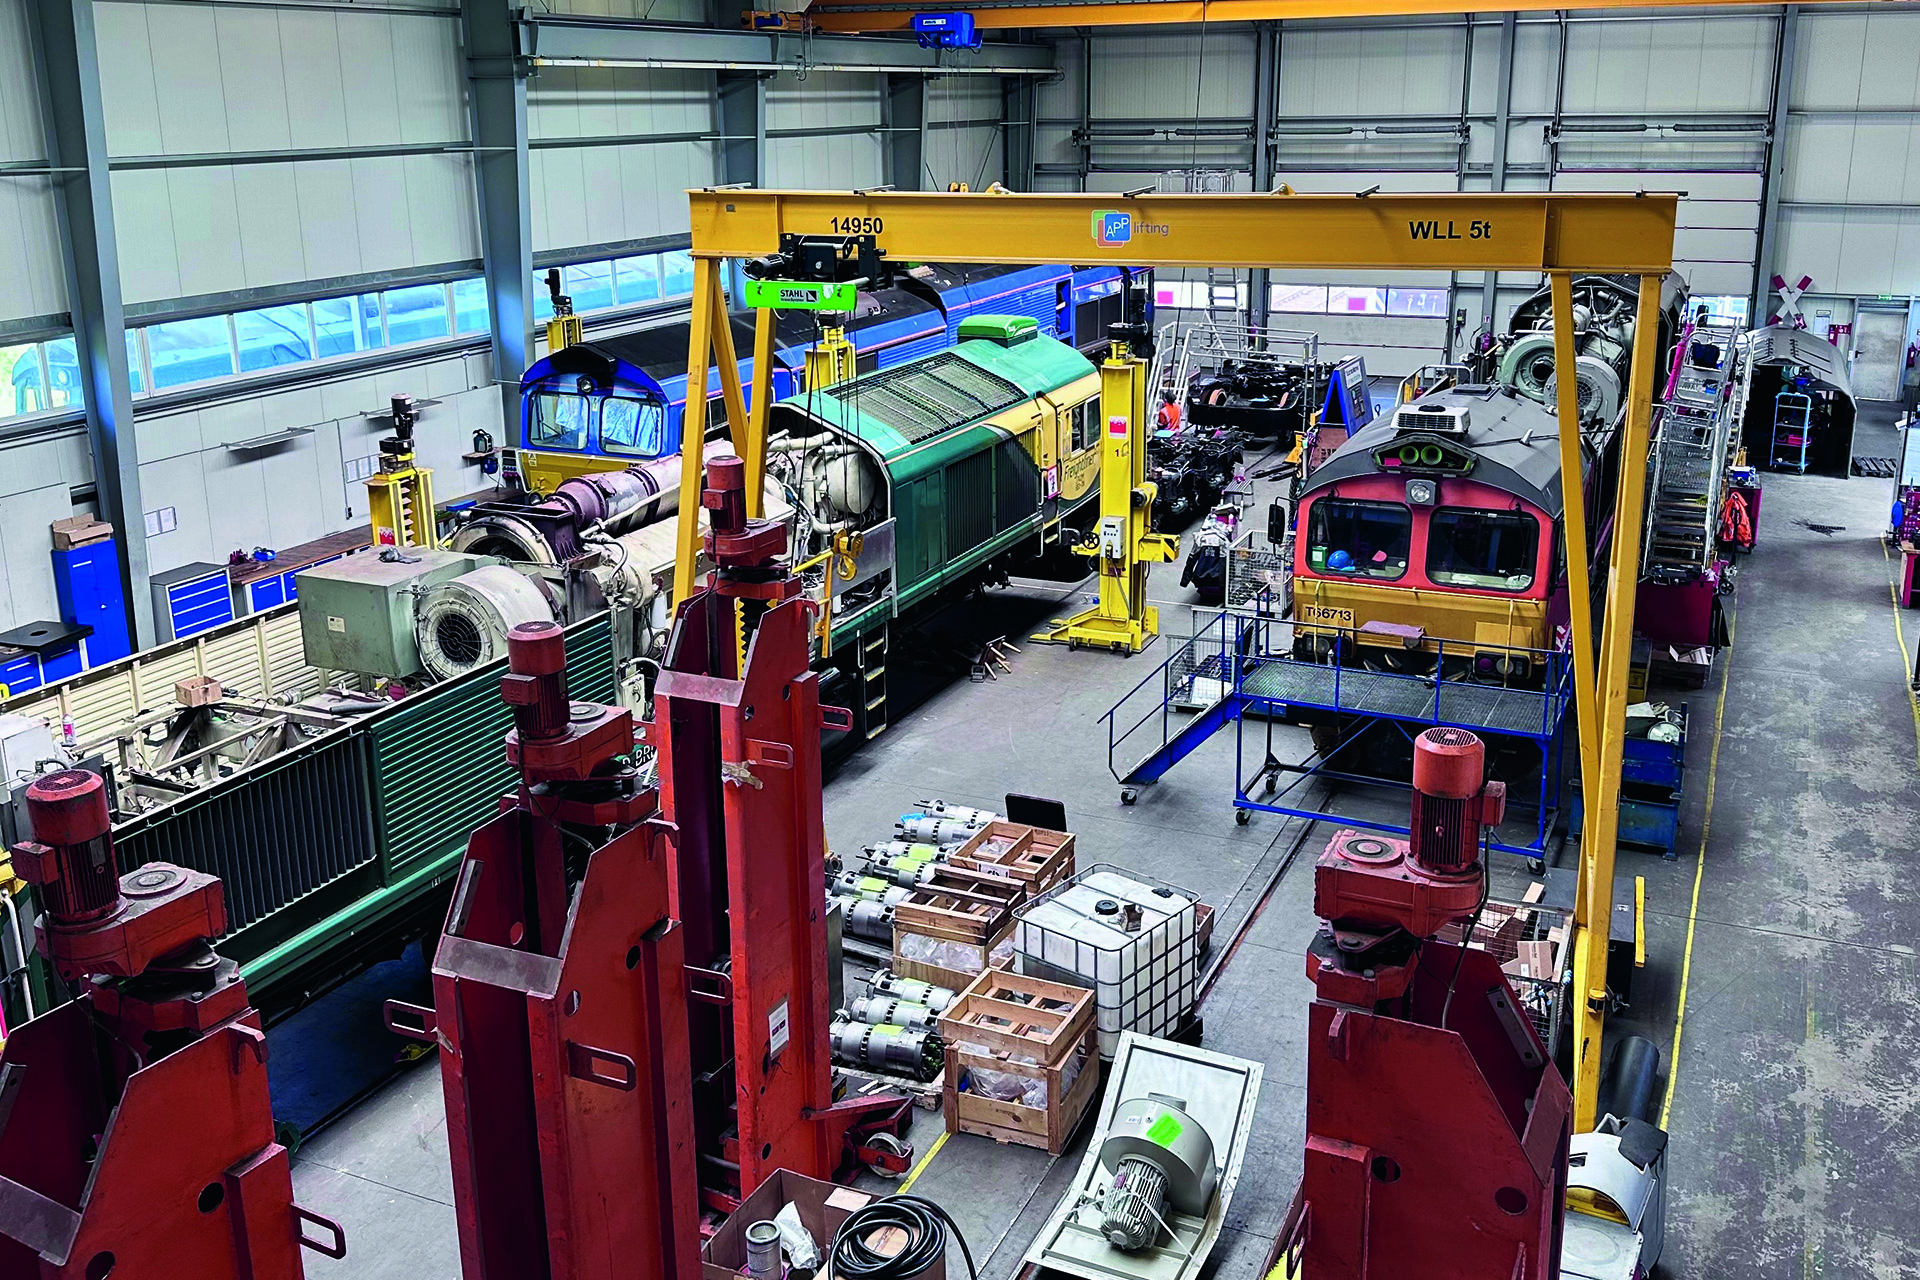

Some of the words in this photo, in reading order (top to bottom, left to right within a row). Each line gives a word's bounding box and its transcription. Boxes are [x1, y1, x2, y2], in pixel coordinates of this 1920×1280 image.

[830, 216, 883, 234] 14950
[1105, 217, 1129, 237] APP
[1133, 221, 1169, 236] lifting
[1408, 220, 1462, 239] WLL
[1469, 220, 1491, 239] 5t
[780, 289, 804, 297] STAHL
[1305, 606, 1352, 621] T66713
